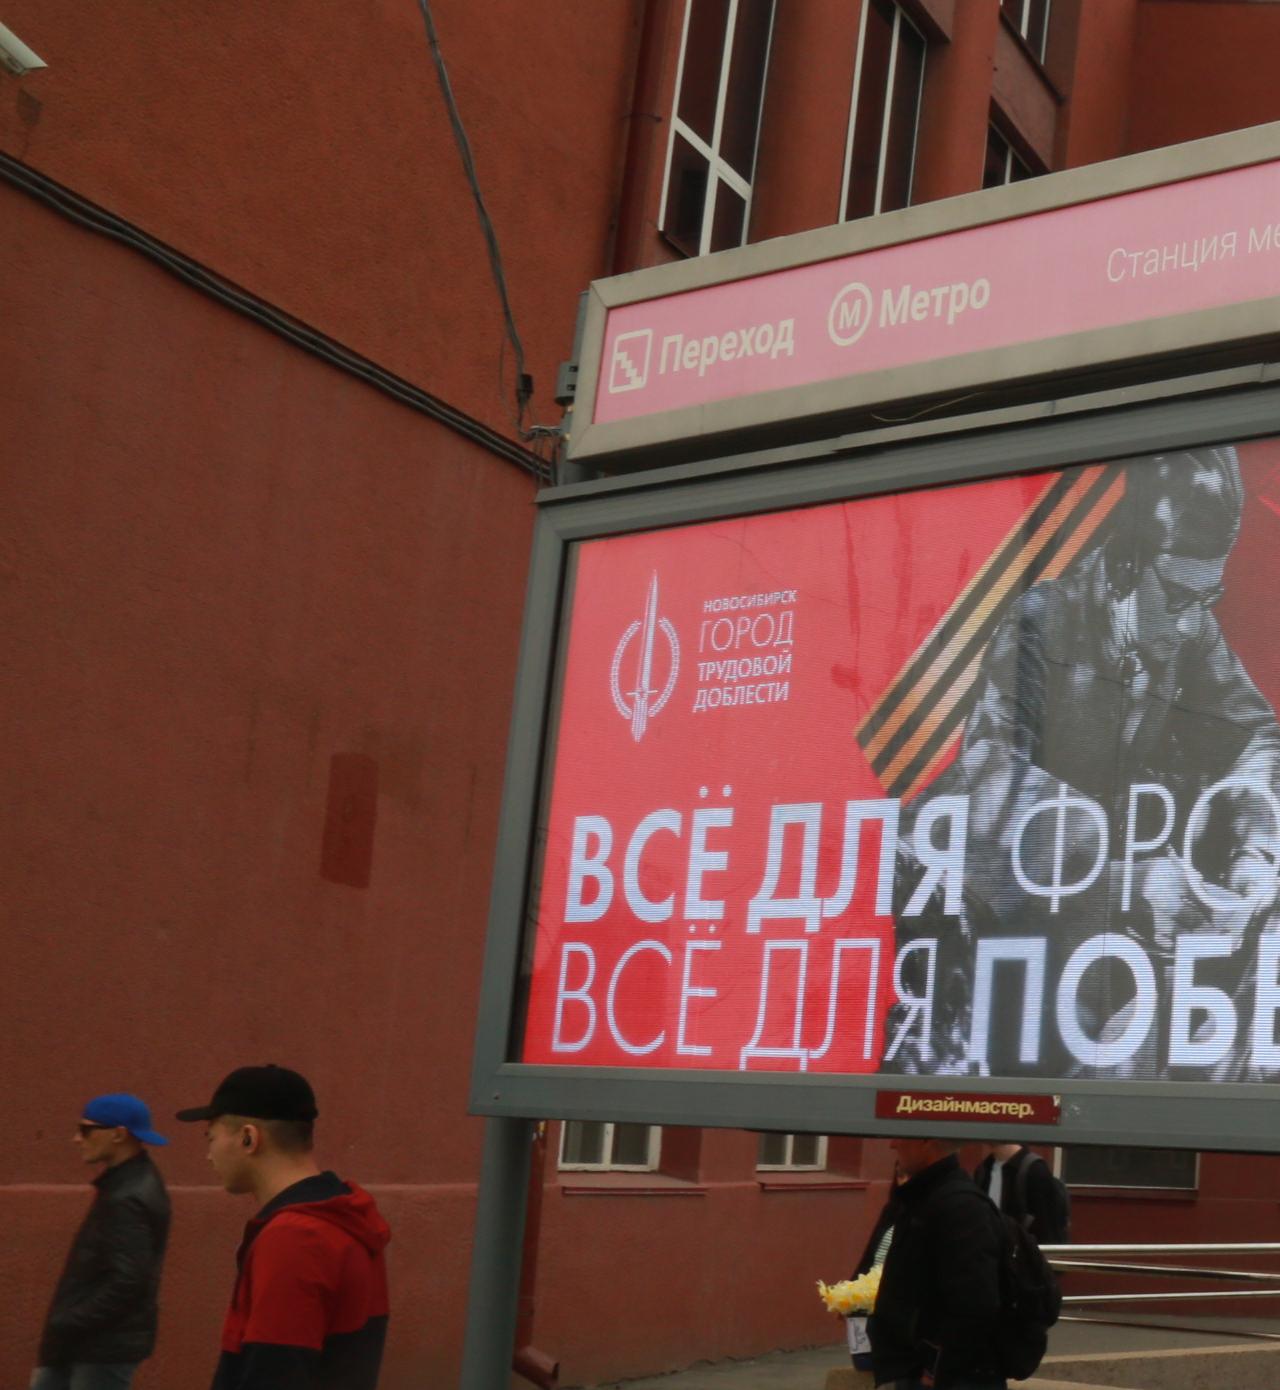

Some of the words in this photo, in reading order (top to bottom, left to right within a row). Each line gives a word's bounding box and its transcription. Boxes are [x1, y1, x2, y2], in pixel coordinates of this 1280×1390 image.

[1106, 226, 1238, 283] Станция
[879, 278, 991, 328] Метро
[658, 318, 795, 377] Переход
[703, 590, 797, 612] НОВОСИБИРСК
[699, 611, 794, 652] ГОРОД
[698, 649, 792, 682] ТРУДОВОЙ
[692, 682, 789, 712] ДОБЛЕСТИ
[563, 784, 735, 924] ВСЁ
[745, 795, 970, 934] ДЛЯ
[551, 924, 723, 1057] ВСЁ
[739, 937, 938, 1072] ДЛЯ
[896, 1095, 1034, 1118] Дизайнмастер.
